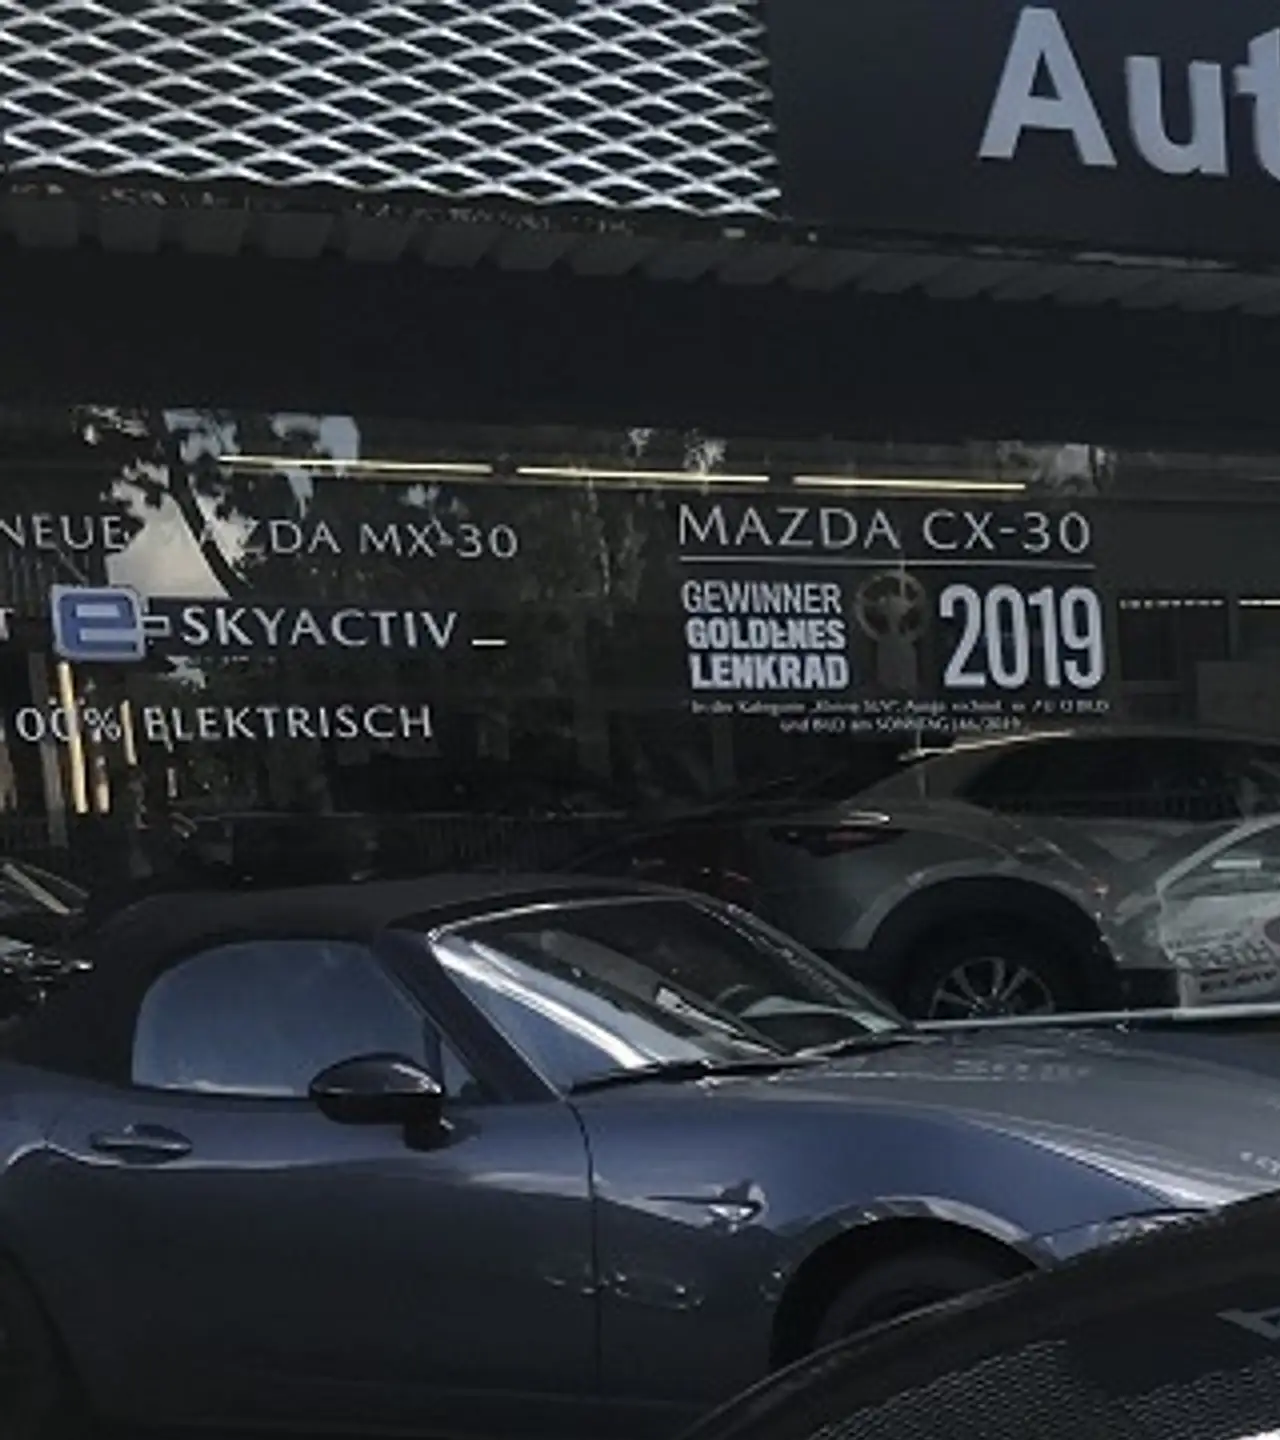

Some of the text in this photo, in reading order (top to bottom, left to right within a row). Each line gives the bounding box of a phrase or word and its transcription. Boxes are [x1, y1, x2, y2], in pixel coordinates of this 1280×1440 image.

[678, 504, 1092, 555] MAZDA CX-30
[182, 606, 458, 648] SKYACTIV
[682, 580, 1105, 690] GEWINNER 2019
[685, 618, 846, 651] GOLDENES
[690, 652, 850, 690] LENKRAD
[0, 704, 432, 742] 00% ELEKTRISCH
